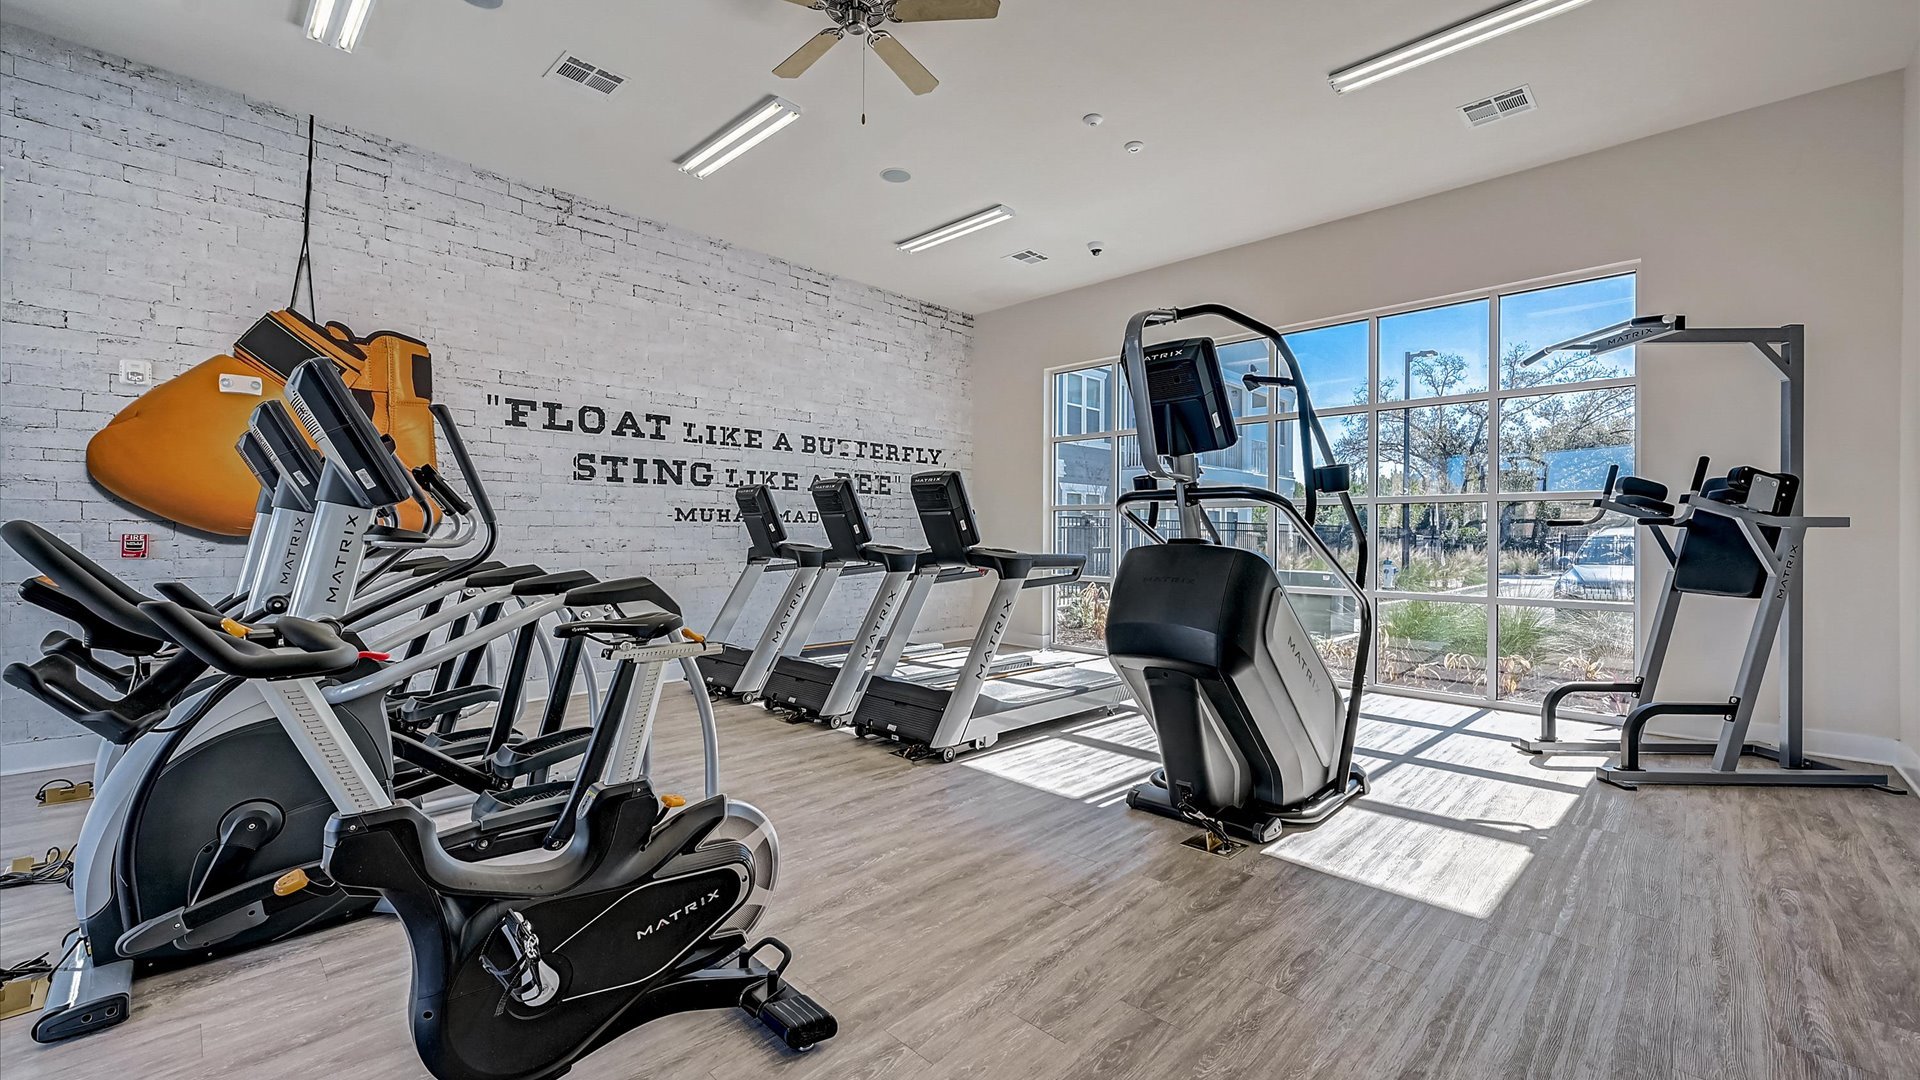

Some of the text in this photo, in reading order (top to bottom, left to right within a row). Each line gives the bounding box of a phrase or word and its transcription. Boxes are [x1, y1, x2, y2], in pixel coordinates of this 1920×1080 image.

[1144, 349, 1183, 361] ATRIX
[1607, 327, 1653, 346] MATRIX
[487, 394, 671, 440] "FLOAT
[683, 421, 762, 449] LIKE
[772, 432, 793, 452] A
[572, 452, 714, 487] STING
[725, 468, 798, 491] LIKE
[667, 507, 819, 523] -MUHAMAD
[280, 517, 305, 584] MATRIX
[326, 514, 359, 602] MATRIX
[1776, 544, 1799, 599] MATRIX
[772, 583, 807, 643] MATRIX
[861, 590, 897, 659] MATRIX
[975, 599, 1013, 679] MATRIX
[1288, 635, 1321, 696] MATRIX
[636, 888, 720, 940] MATRIX
